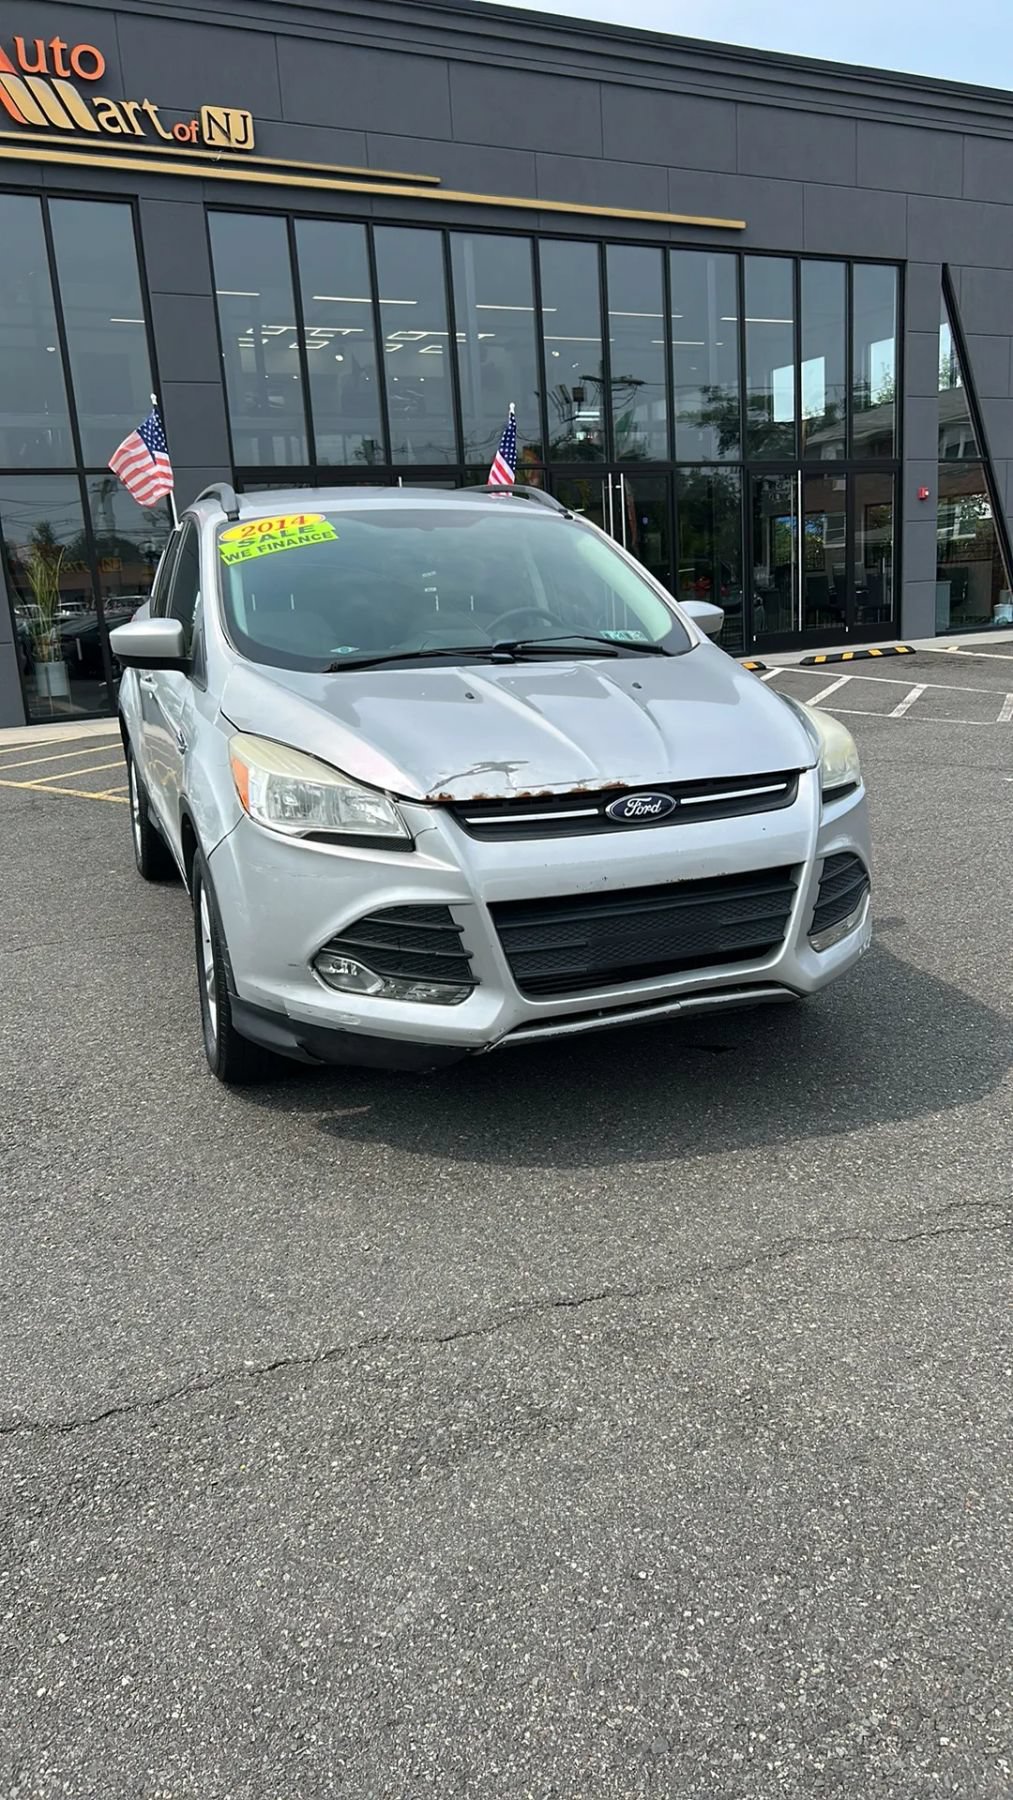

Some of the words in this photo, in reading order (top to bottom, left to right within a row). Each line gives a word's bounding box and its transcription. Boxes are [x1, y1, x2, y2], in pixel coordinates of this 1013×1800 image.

[172, 119, 199, 144] of
[205, 108, 251, 147] NJ
[237, 524, 316, 549] SALE
[241, 515, 308, 538] 2014
[225, 548, 253, 563] WE
[256, 531, 333, 553] FINANCE
[623, 796, 663, 817] Ford
